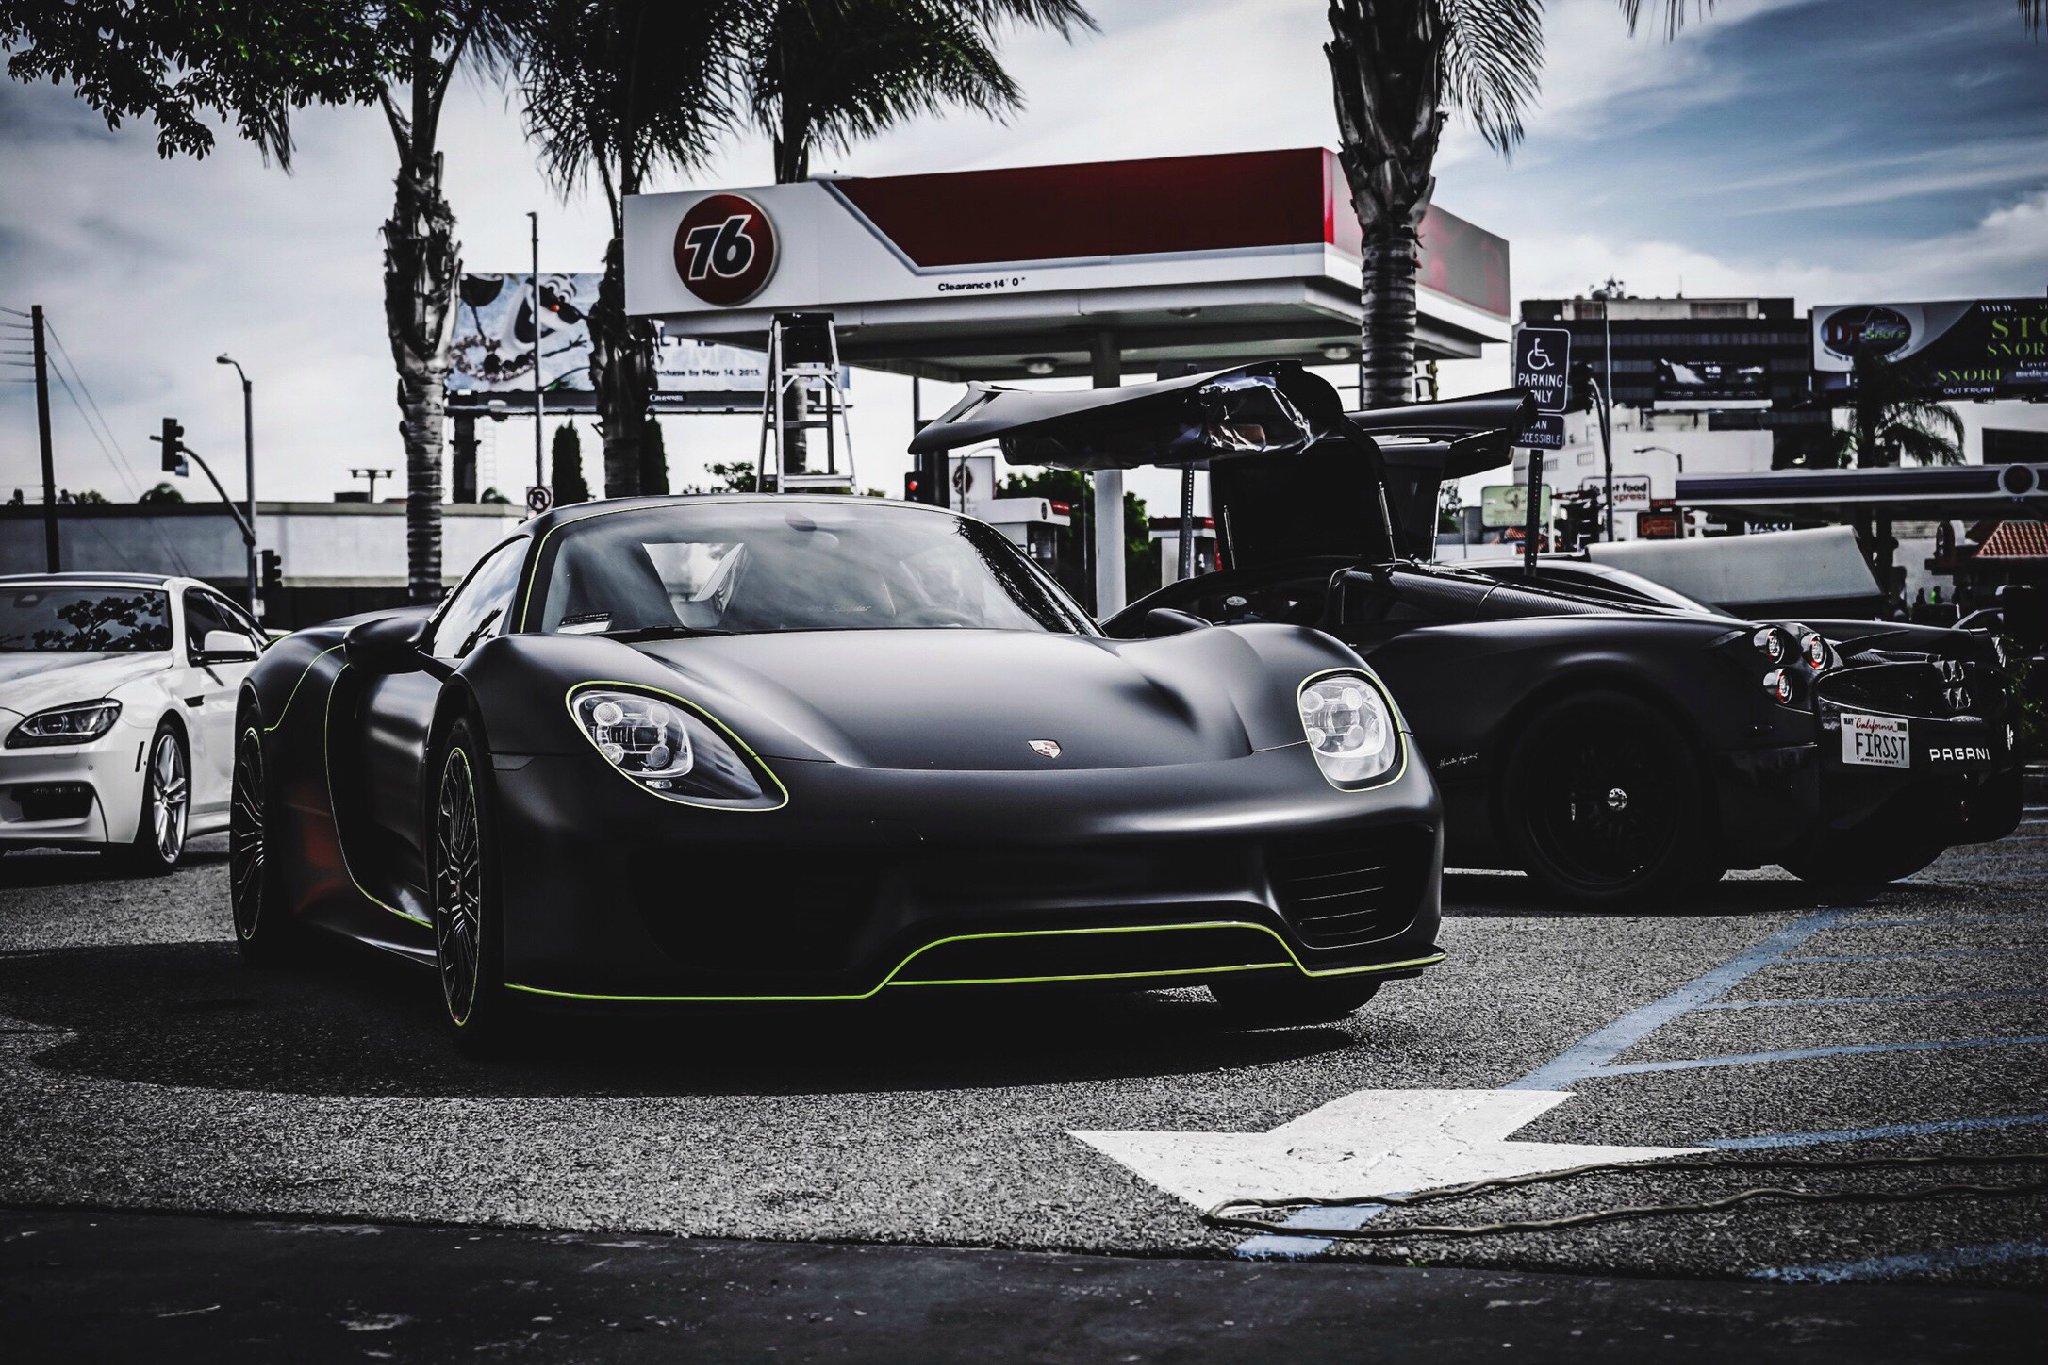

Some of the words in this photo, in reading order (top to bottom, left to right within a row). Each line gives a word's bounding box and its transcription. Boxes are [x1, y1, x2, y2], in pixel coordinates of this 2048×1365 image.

[685, 214, 755, 280] 76
[938, 282, 992, 292] Clearance
[1518, 372, 1563, 388] PARKING
[1530, 389, 1553, 404] NLY
[1531, 420, 1547, 430] AN
[1519, 432, 1561, 445] CESSIBLE
[1623, 482, 1647, 492] food
[1613, 493, 1647, 502] xpress
[1856, 717, 1898, 733] California
[1855, 732, 1907, 761] FIRSST
[1929, 747, 1991, 761] PAGANI
